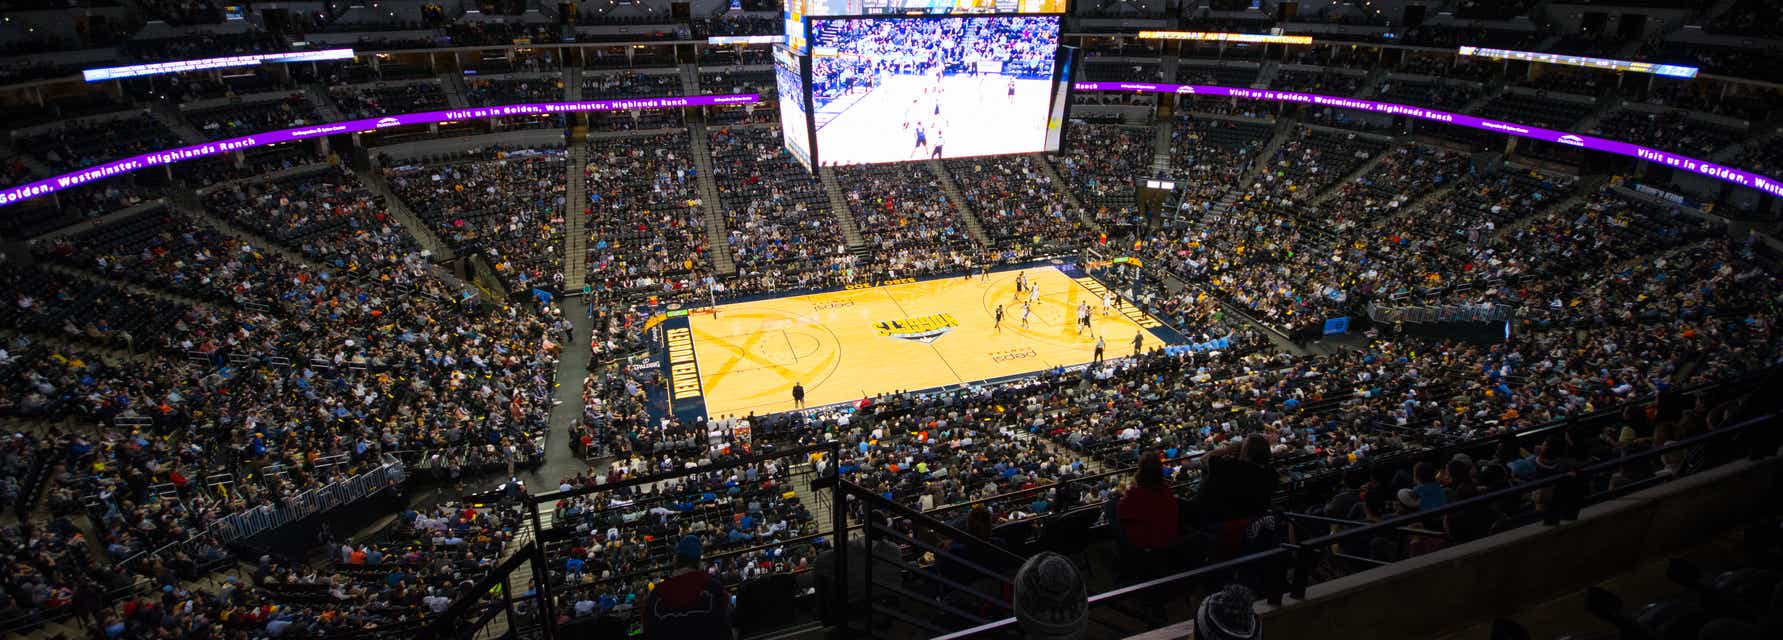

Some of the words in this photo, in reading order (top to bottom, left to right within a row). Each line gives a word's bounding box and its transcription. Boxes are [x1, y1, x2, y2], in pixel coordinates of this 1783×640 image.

[445, 110, 472, 119] Visit
[474, 109, 487, 117] us
[489, 107, 501, 116] in
[503, 106, 542, 115] Golden,
[545, 102, 609, 112] Westminster,
[611, 99, 658, 109] Highlands
[660, 97, 688, 106] Ranch
[1229, 88, 1250, 97] Visit
[1264, 91, 1274, 99] in
[1376, 103, 1423, 117] Highlands
[1425, 111, 1453, 121] Ranch
[0, 186, 54, 206] Golden,
[58, 160, 142, 188] Westminster,
[146, 145, 216, 165] Highlands
[219, 137, 256, 151] Ranch
[1637, 148, 1664, 162] Visit
[1666, 156, 1680, 166] us
[1683, 159, 1696, 170] in
[1699, 163, 1749, 184] Golden,
[667, 327, 695, 363] NUGGETS
[671, 363, 701, 400] DENVER
